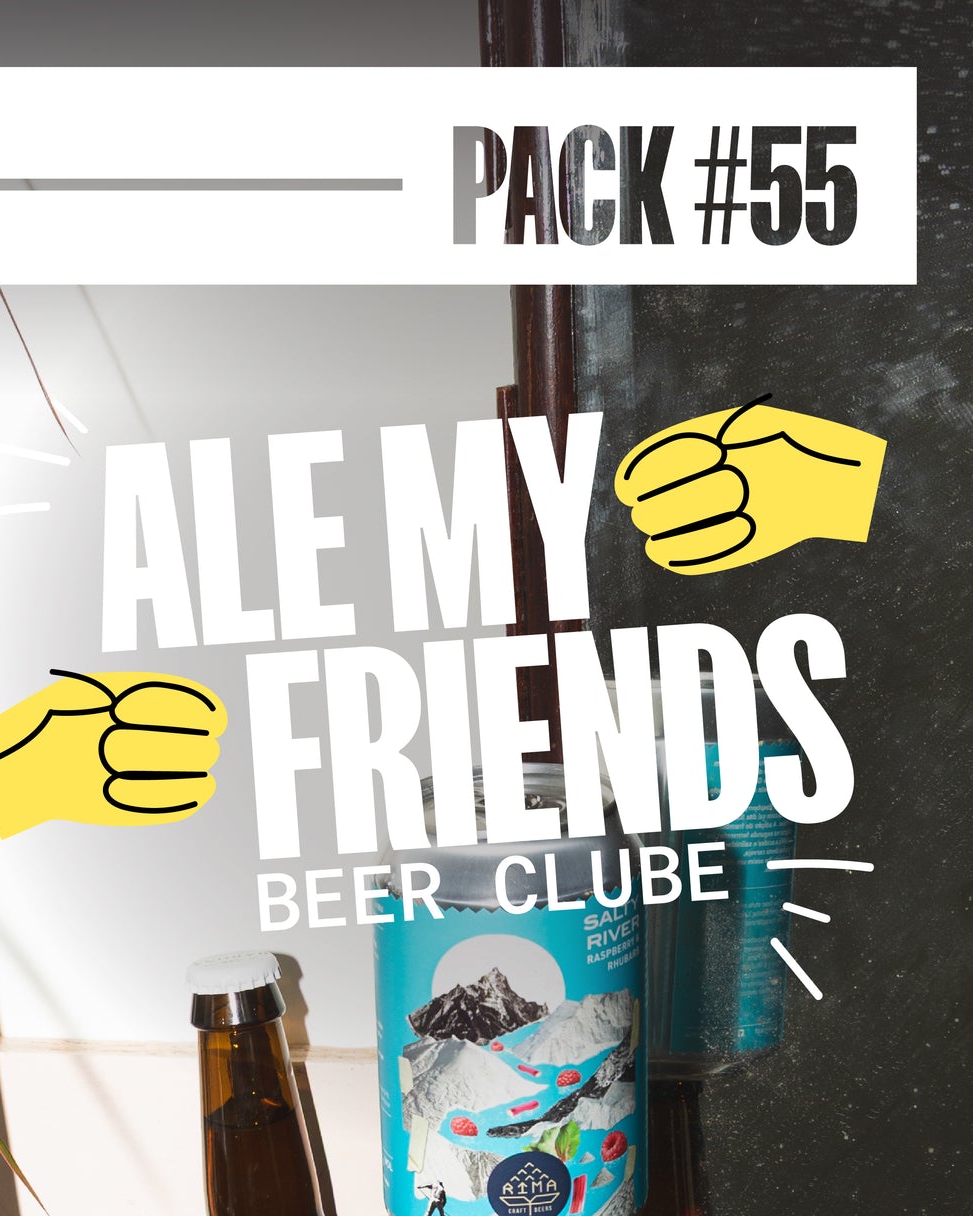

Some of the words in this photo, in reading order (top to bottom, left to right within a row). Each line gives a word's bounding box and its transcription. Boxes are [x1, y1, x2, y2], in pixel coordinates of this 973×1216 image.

[583, 896, 638, 931] SALTY
[587, 914, 640, 951] RIVER
[503, 1180, 557, 1196] RIMA
[508, 1207, 527, 1215] CRAFT
[534, 1204, 553, 1213] BEERS
